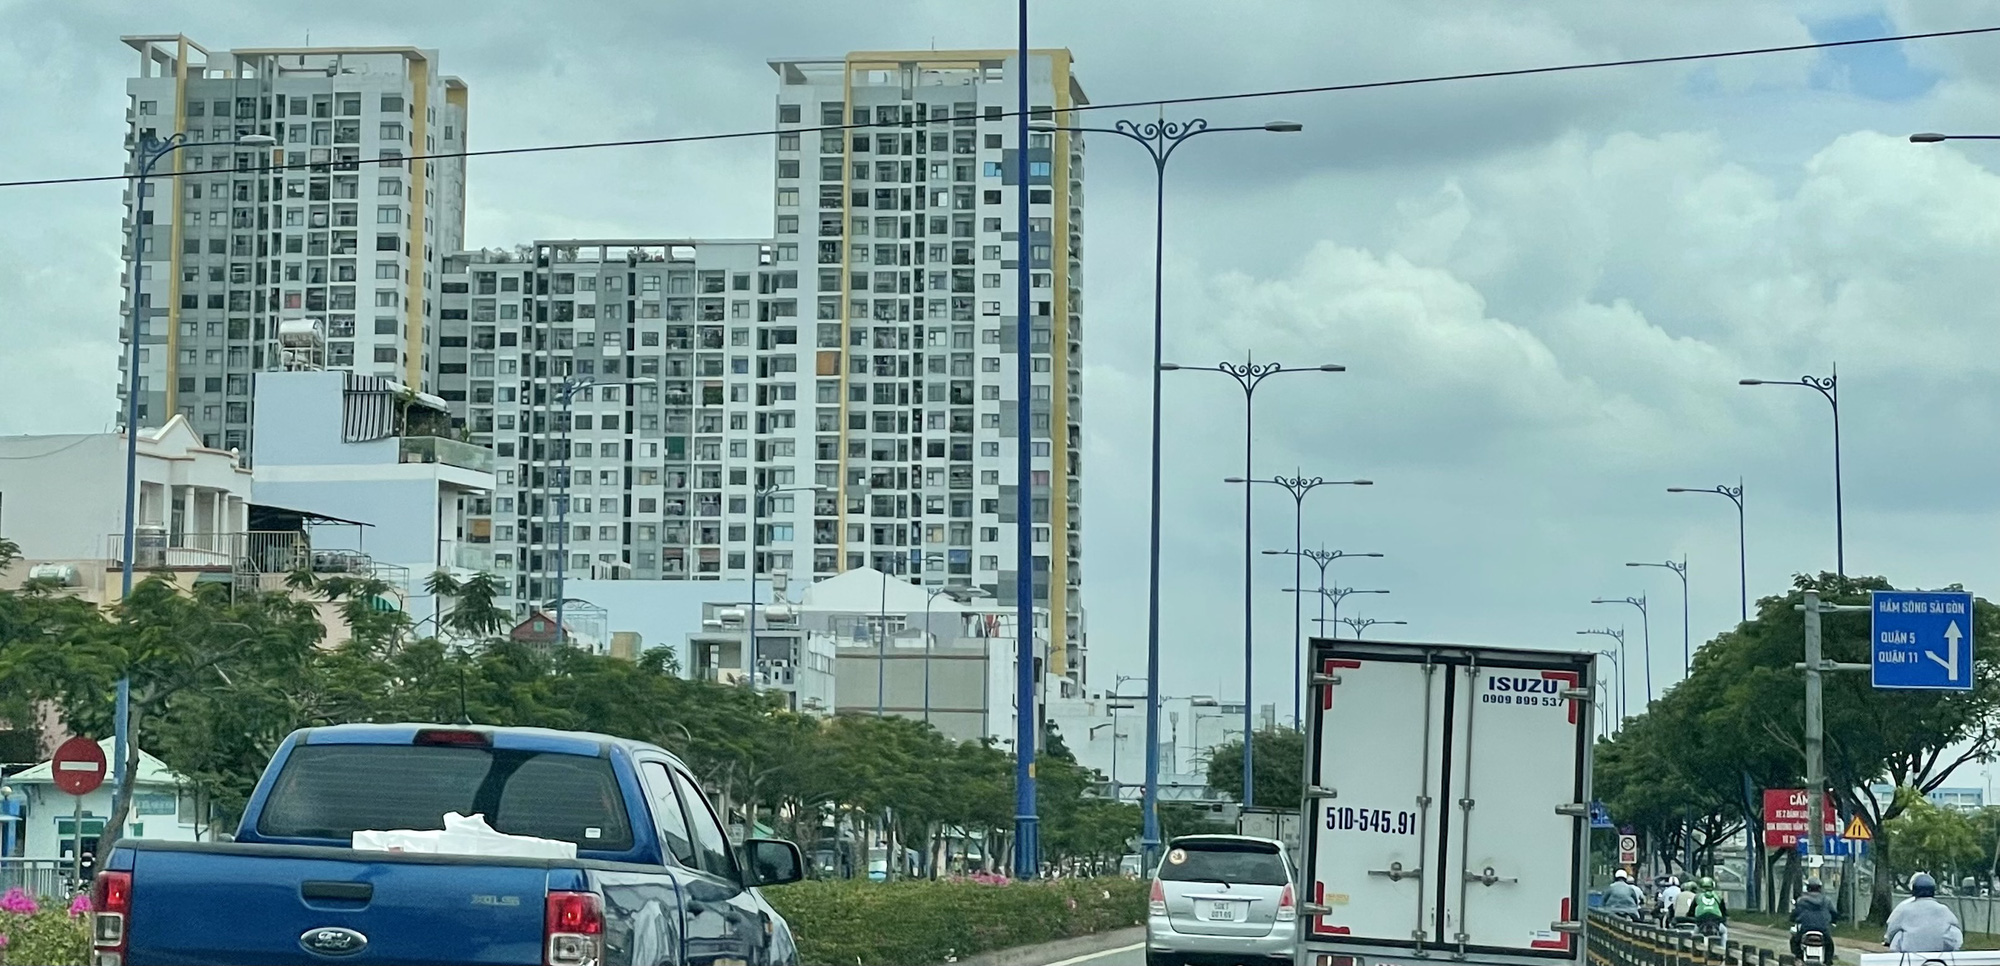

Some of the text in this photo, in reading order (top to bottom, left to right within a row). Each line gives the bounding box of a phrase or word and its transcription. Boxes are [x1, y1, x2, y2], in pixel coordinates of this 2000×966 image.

[1902, 600, 1928, 614] SÔNG
[1929, 600, 1944, 614] SÀI
[1945, 600, 1965, 614] GÒN
[1880, 630, 1916, 644] QUẬN 5
[1878, 649, 1918, 664] QUẬN 11
[1489, 676, 1558, 694] ISUZU
[1482, 694, 1564, 707] 0909 899 537
[1326, 806, 1416, 836] 51D-545.91
[315, 931, 351, 948] Ford
